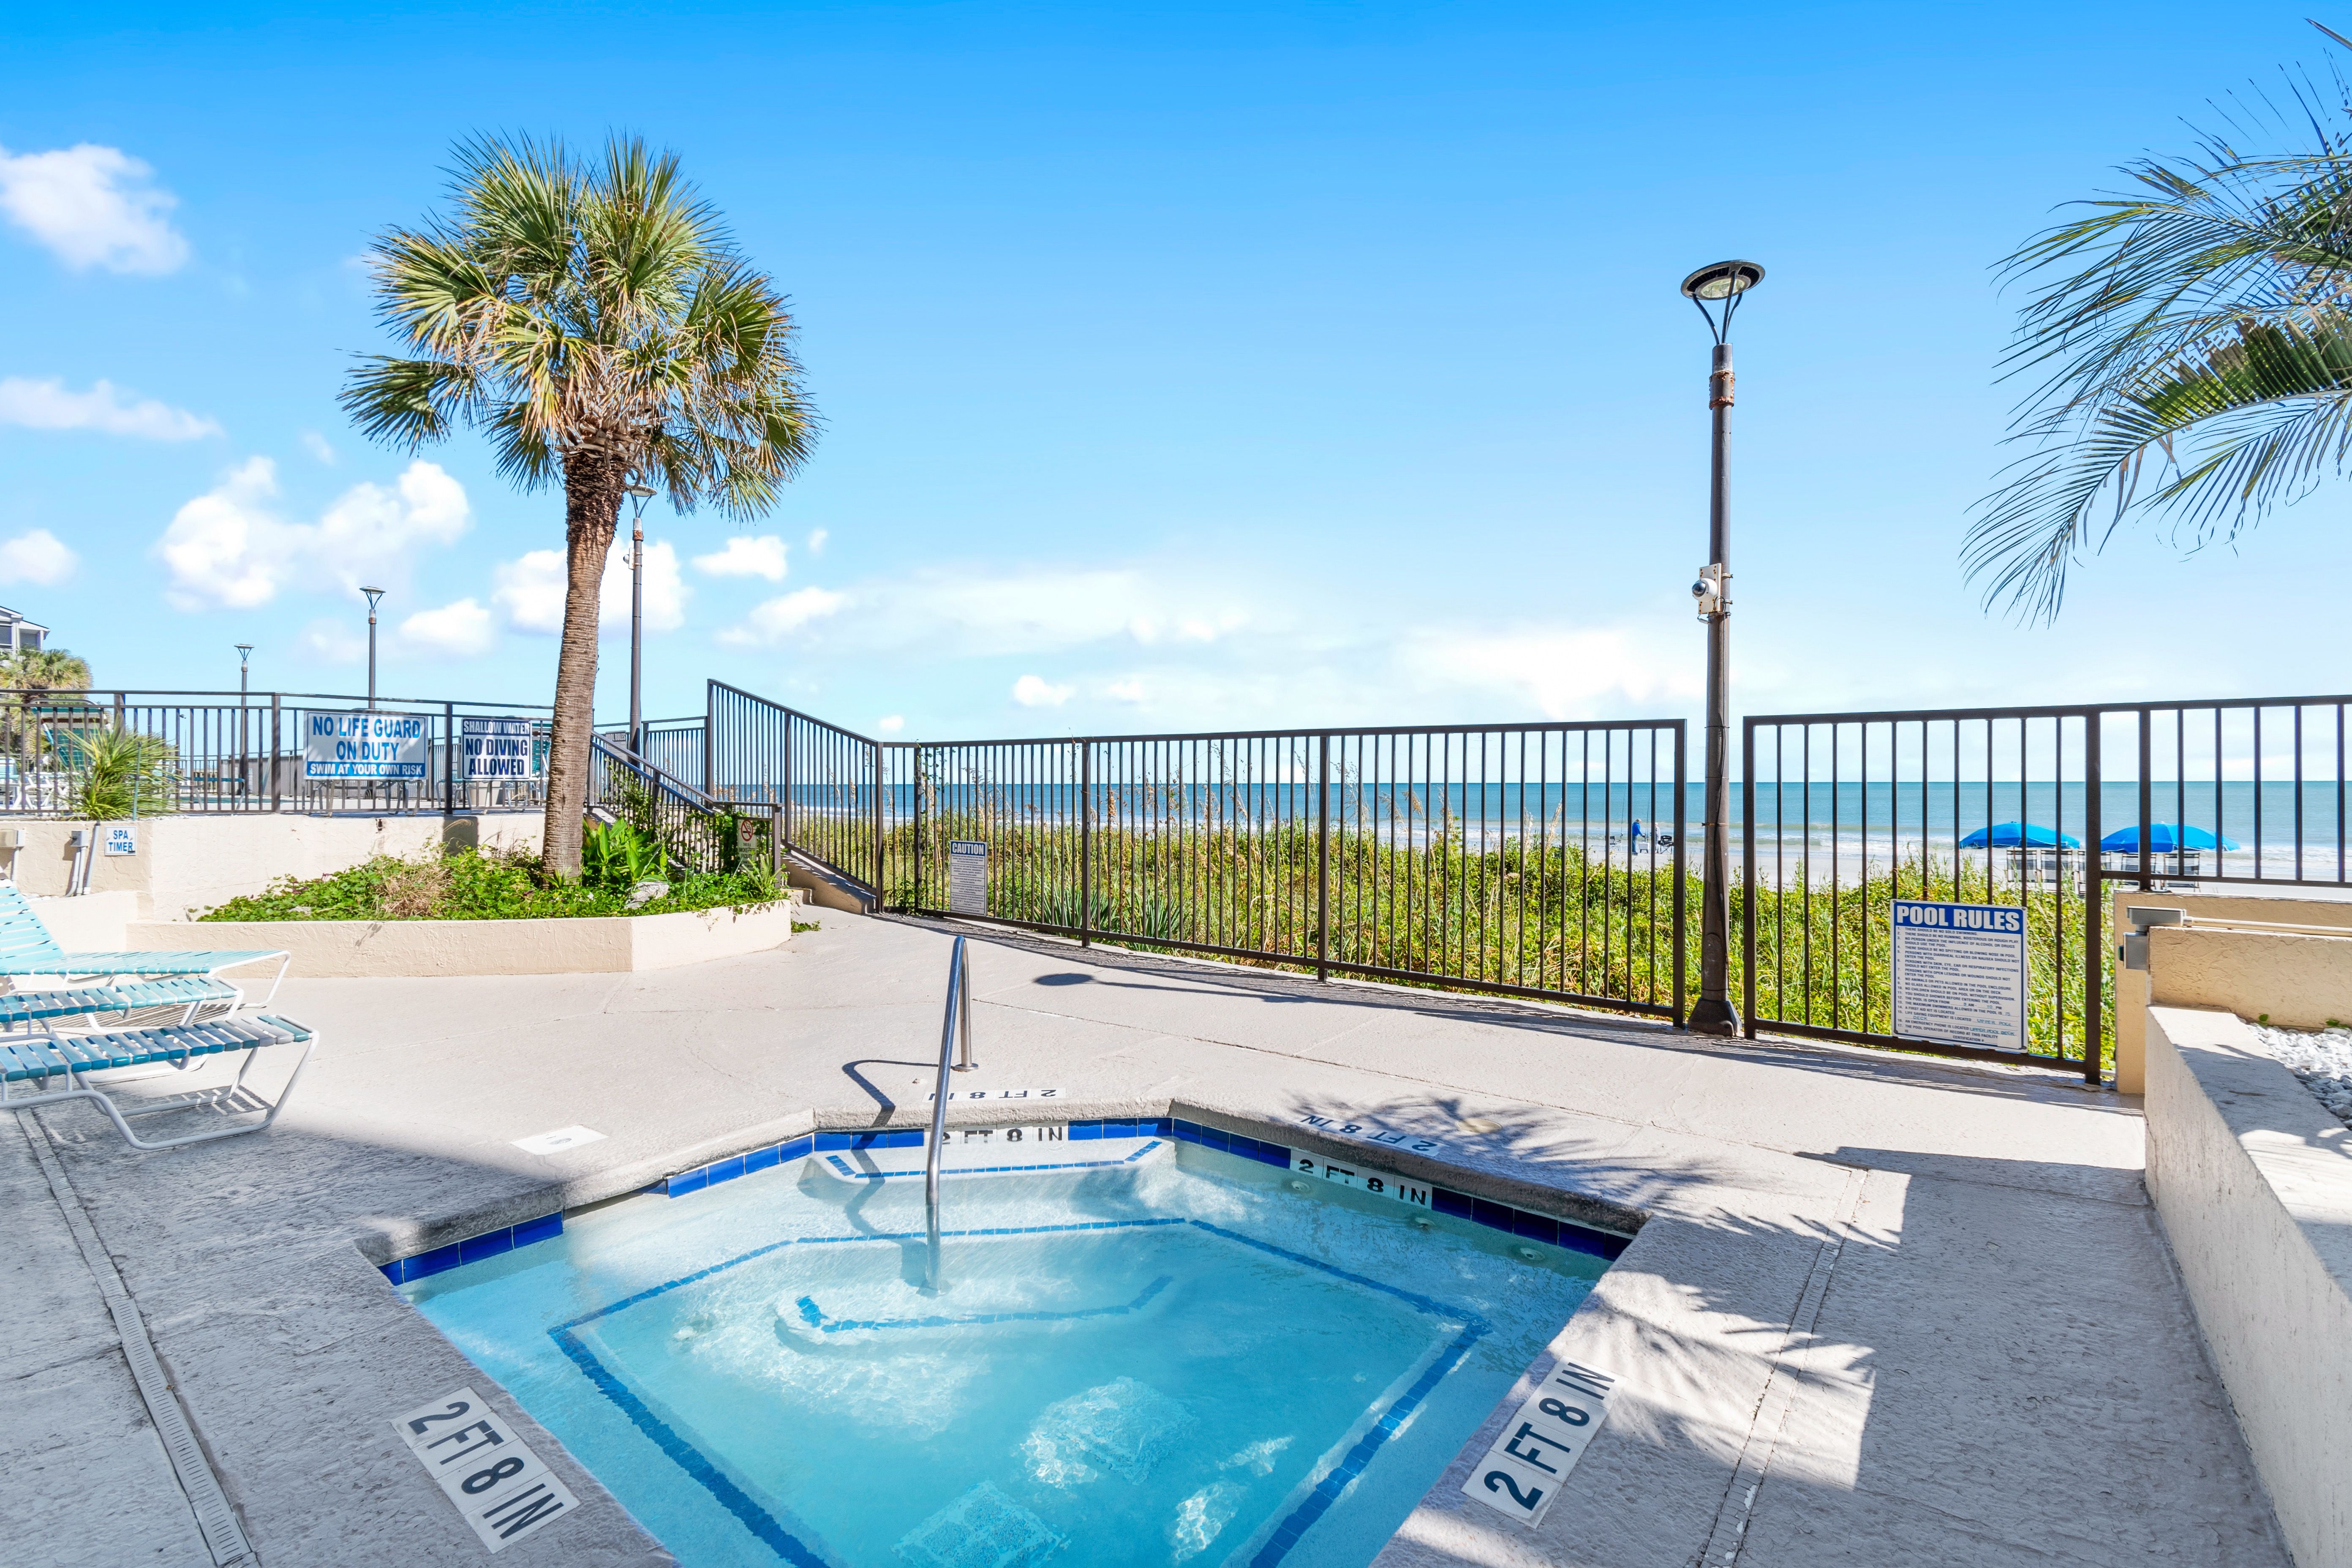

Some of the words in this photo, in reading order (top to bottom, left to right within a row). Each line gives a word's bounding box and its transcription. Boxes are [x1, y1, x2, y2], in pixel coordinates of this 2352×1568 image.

[313, 716, 333, 736] NO
[338, 717, 369, 737] LIFE
[374, 718, 420, 738] GUARD
[463, 721, 503, 733] SHALLOW
[504, 722, 530, 735] WATER
[336, 741, 357, 760] ON
[362, 742, 399, 761] DUTY
[466, 738, 482, 755] NO
[486, 739, 528, 756] DIVING
[310, 763, 337, 775] SWIM
[338, 763, 350, 774] AT
[352, 763, 377, 775] YOUR
[378, 764, 399, 775] OWN
[402, 765, 422, 775] RISK
[468, 759, 524, 775] ALLOWED
[114, 830, 128, 840] SPA
[109, 842, 133, 852] TIMER
[952, 843, 984, 855] CAUTION
[1897, 906, 1948, 926] POOL
[1954, 909, 2020, 931] RULES
[999, 1090, 1028, 1098] FT
[1301, 1116, 1334, 1127] IN
[1339, 1124, 1363, 1133] 8
[1039, 1127, 1062, 1141] IN
[1367, 1132, 1407, 1144] FT
[1412, 1141, 1438, 1151] 2
[1298, 1159, 1314, 1174] 2
[1326, 1165, 1355, 1184] FT
[1367, 1178, 1384, 1192] 8
[1399, 1185, 1426, 1205] IN
[1555, 1362, 1615, 1401] IN
[408, 1402, 470, 1435] 2
[1538, 1397, 1590, 1427] 8
[427, 1420, 504, 1465] FT
[1504, 1421, 1571, 1475] FT
[461, 1457, 524, 1494] 8
[1484, 1470, 1544, 1511] 2
[482, 1483, 564, 1540] IN
